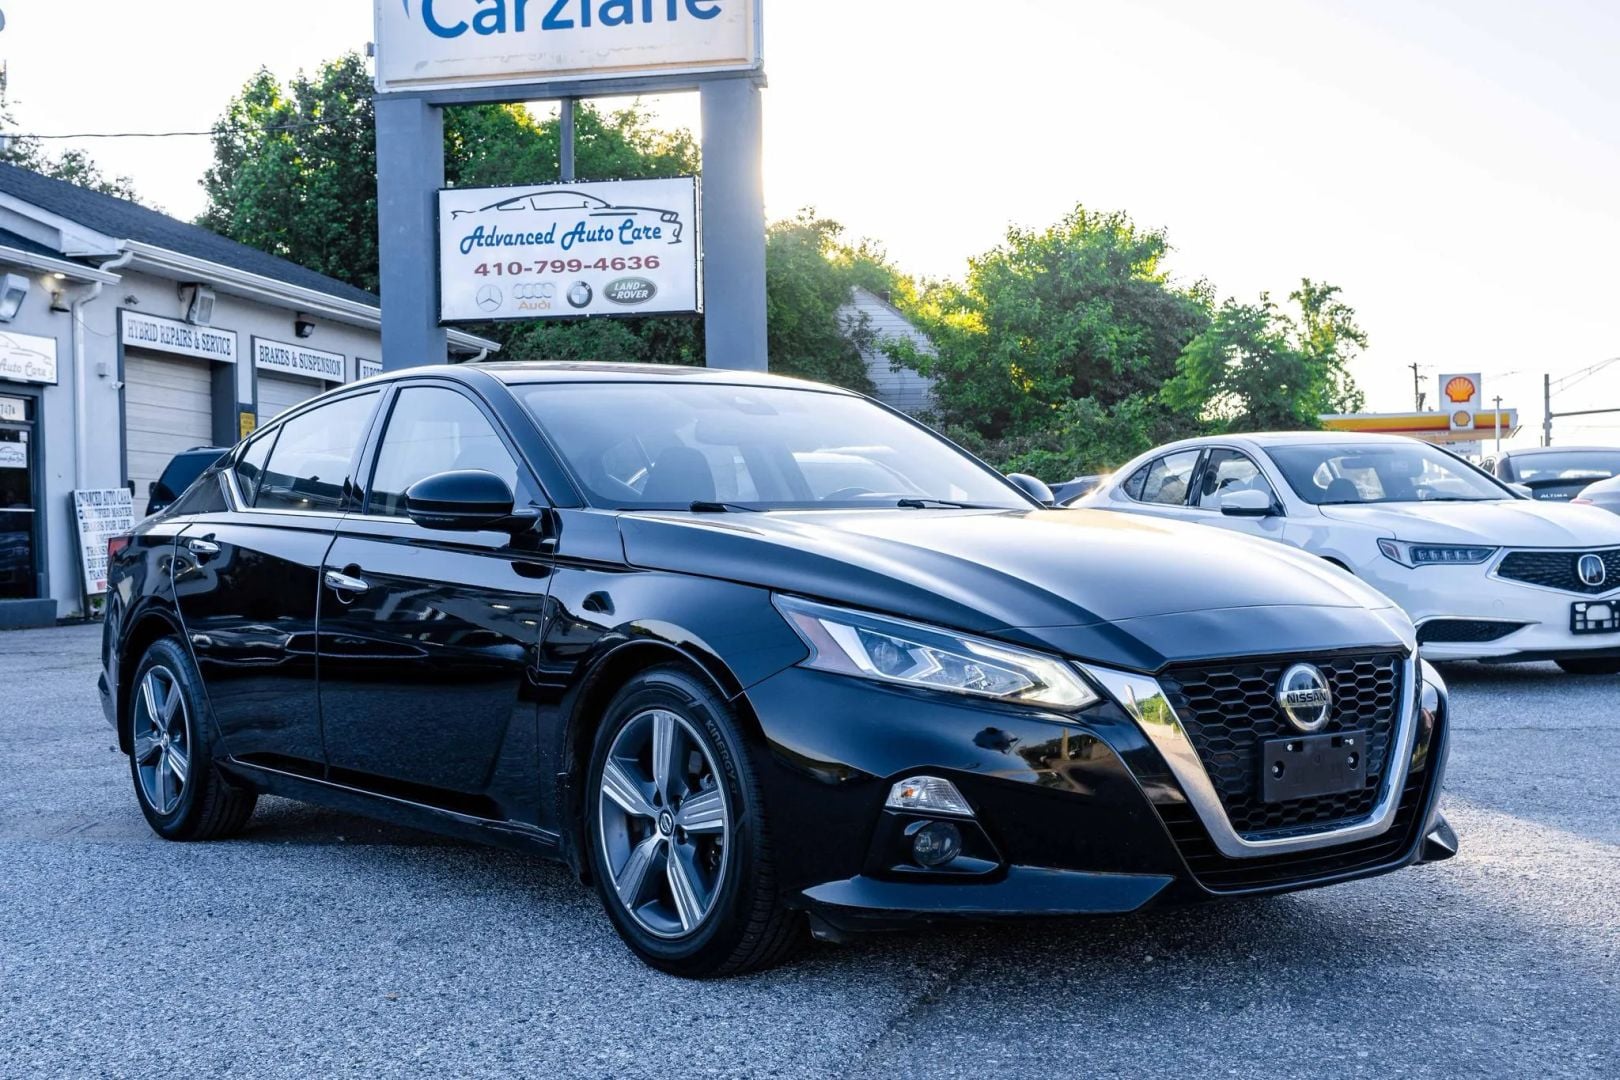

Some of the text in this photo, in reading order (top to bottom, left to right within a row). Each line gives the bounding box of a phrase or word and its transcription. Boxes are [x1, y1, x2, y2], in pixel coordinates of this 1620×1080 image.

[460, 218, 662, 255] Advanced Auto Care
[474, 255, 661, 277] 410-799-4636
[518, 300, 551, 311] Audi
[127, 319, 231, 356] HYBRID REPAIRS & SERVICE
[259, 345, 342, 376] BRAKES & SUSPENSION
[1286, 692, 1327, 704] NISSAN
